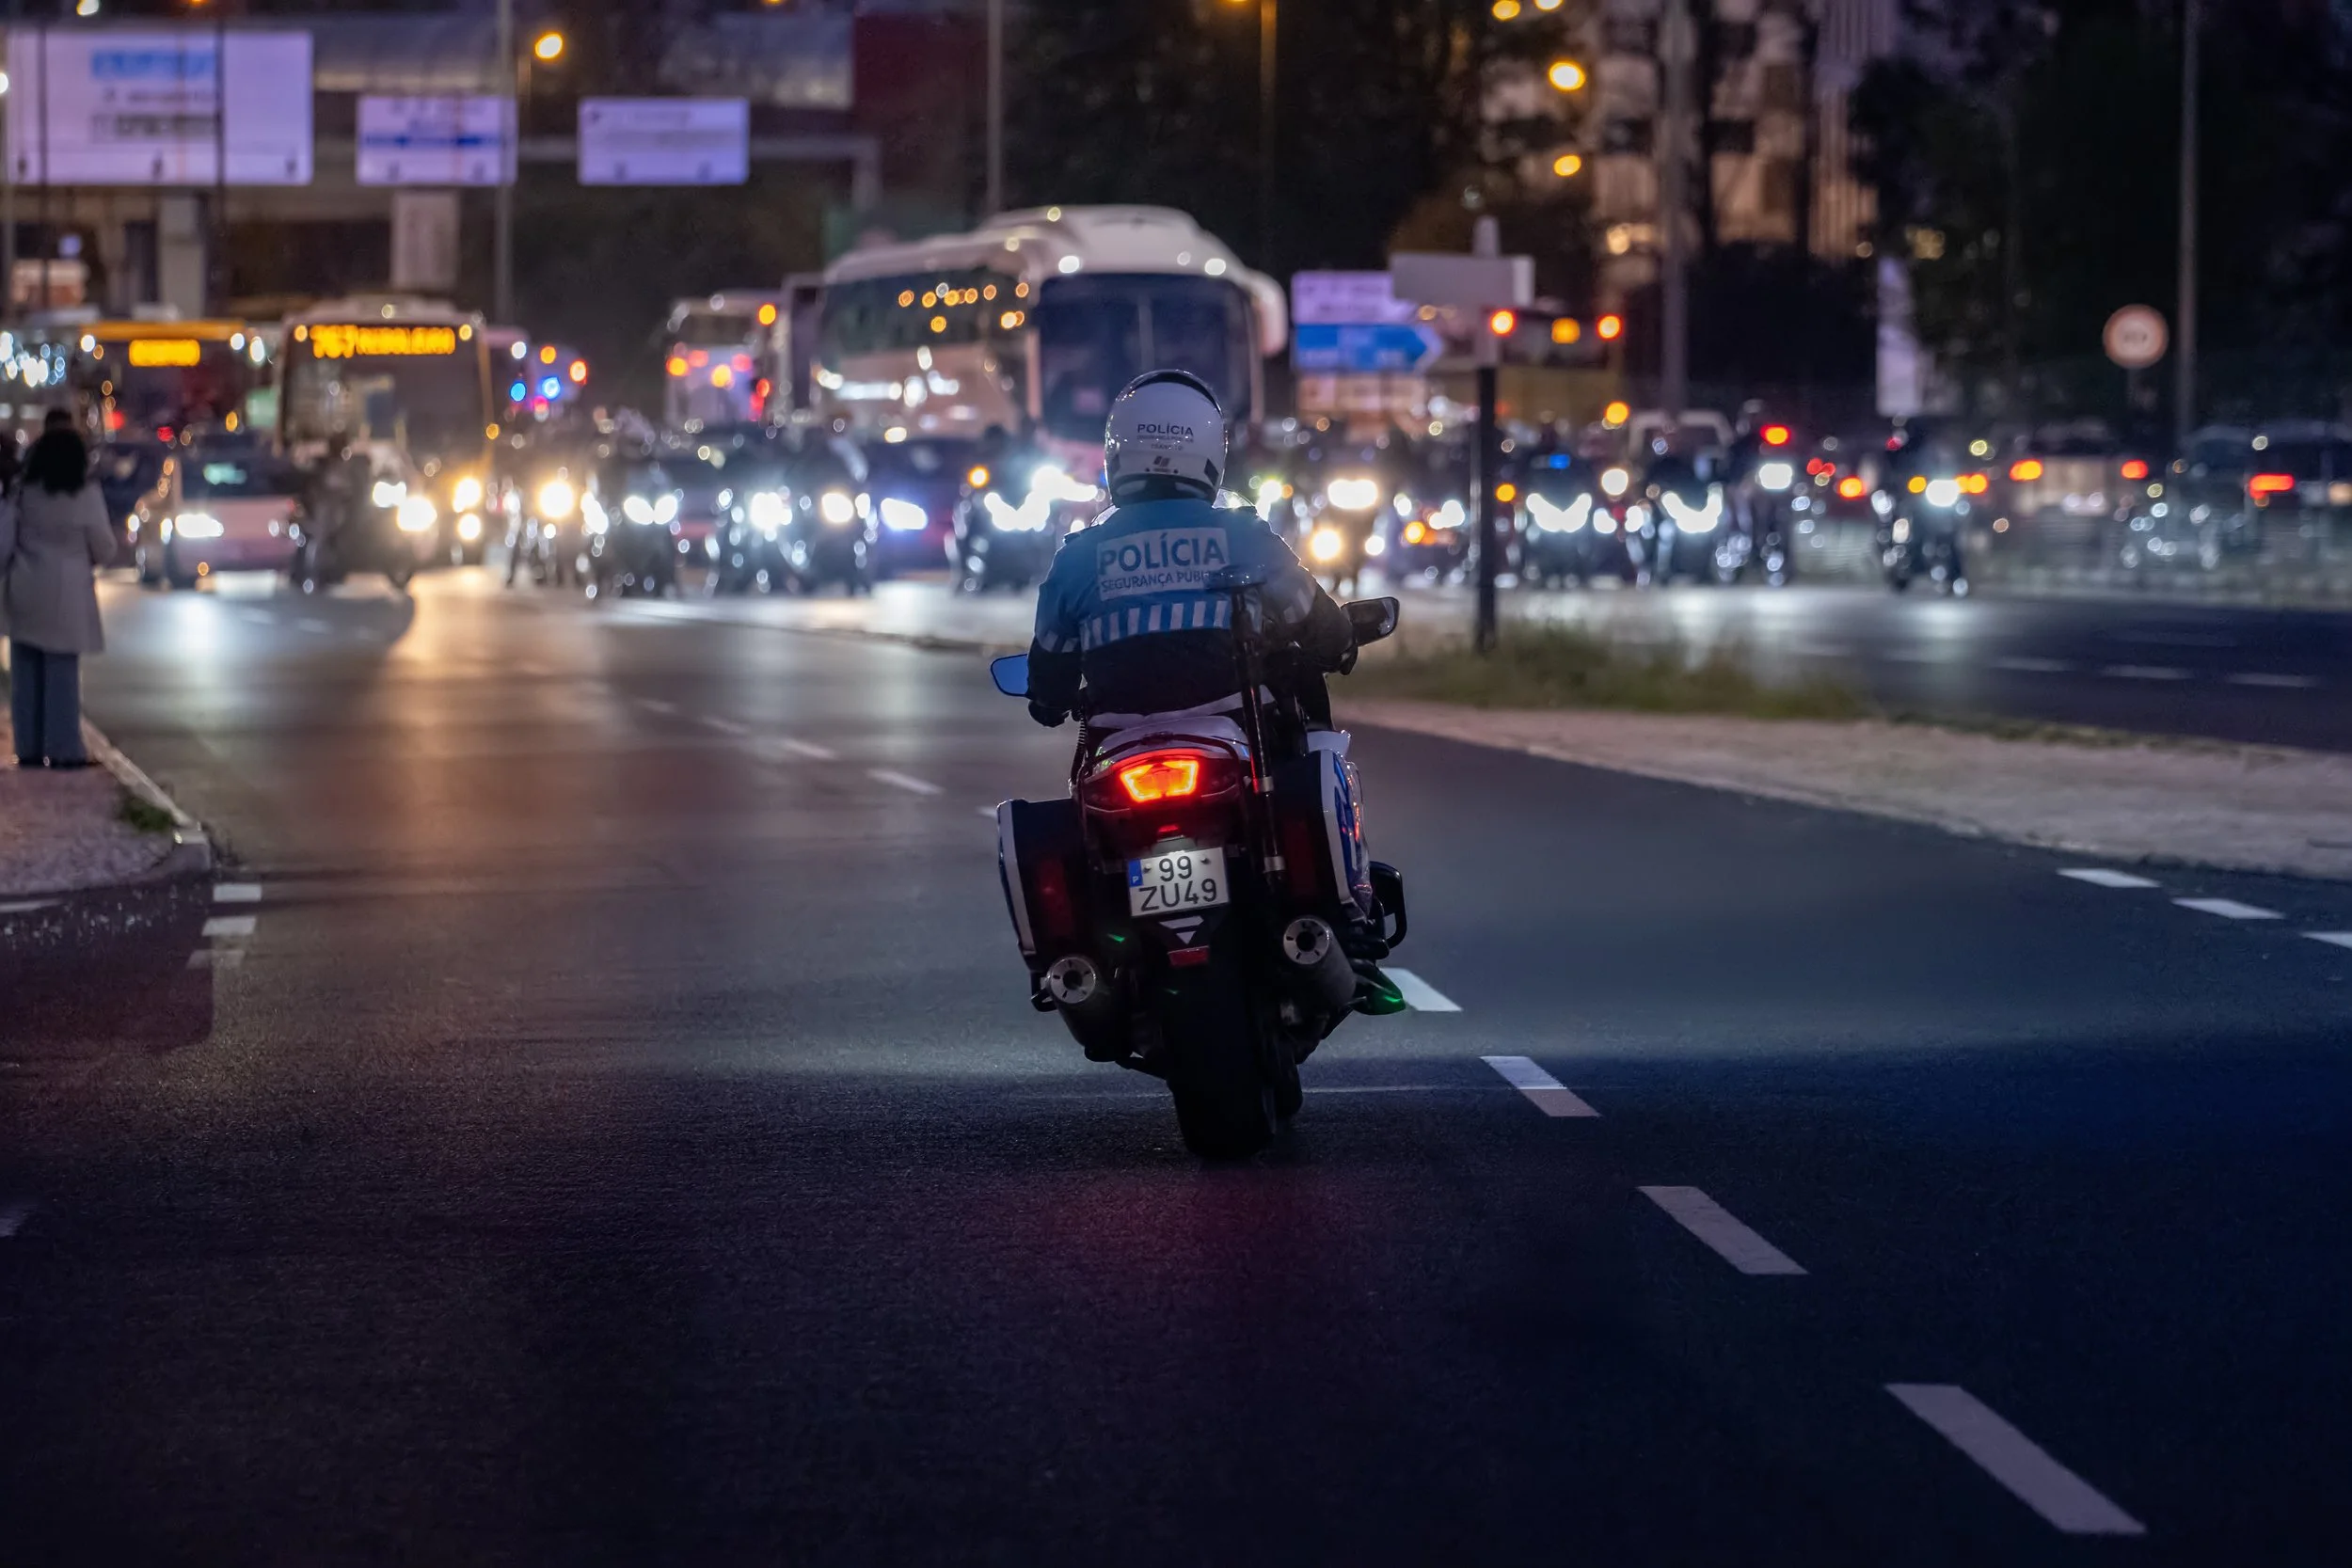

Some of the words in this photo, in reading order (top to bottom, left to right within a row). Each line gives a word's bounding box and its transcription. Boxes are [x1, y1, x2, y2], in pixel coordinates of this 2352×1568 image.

[1136, 422, 1194, 436] POLÍCIA
[1099, 532, 1226, 576] POLÍCIA
[1101, 572, 1174, 593] SEGURANÇA
[1132, 875, 1139, 883] P
[1158, 855, 1192, 882] 99
[1138, 878, 1217, 912] ZU49
